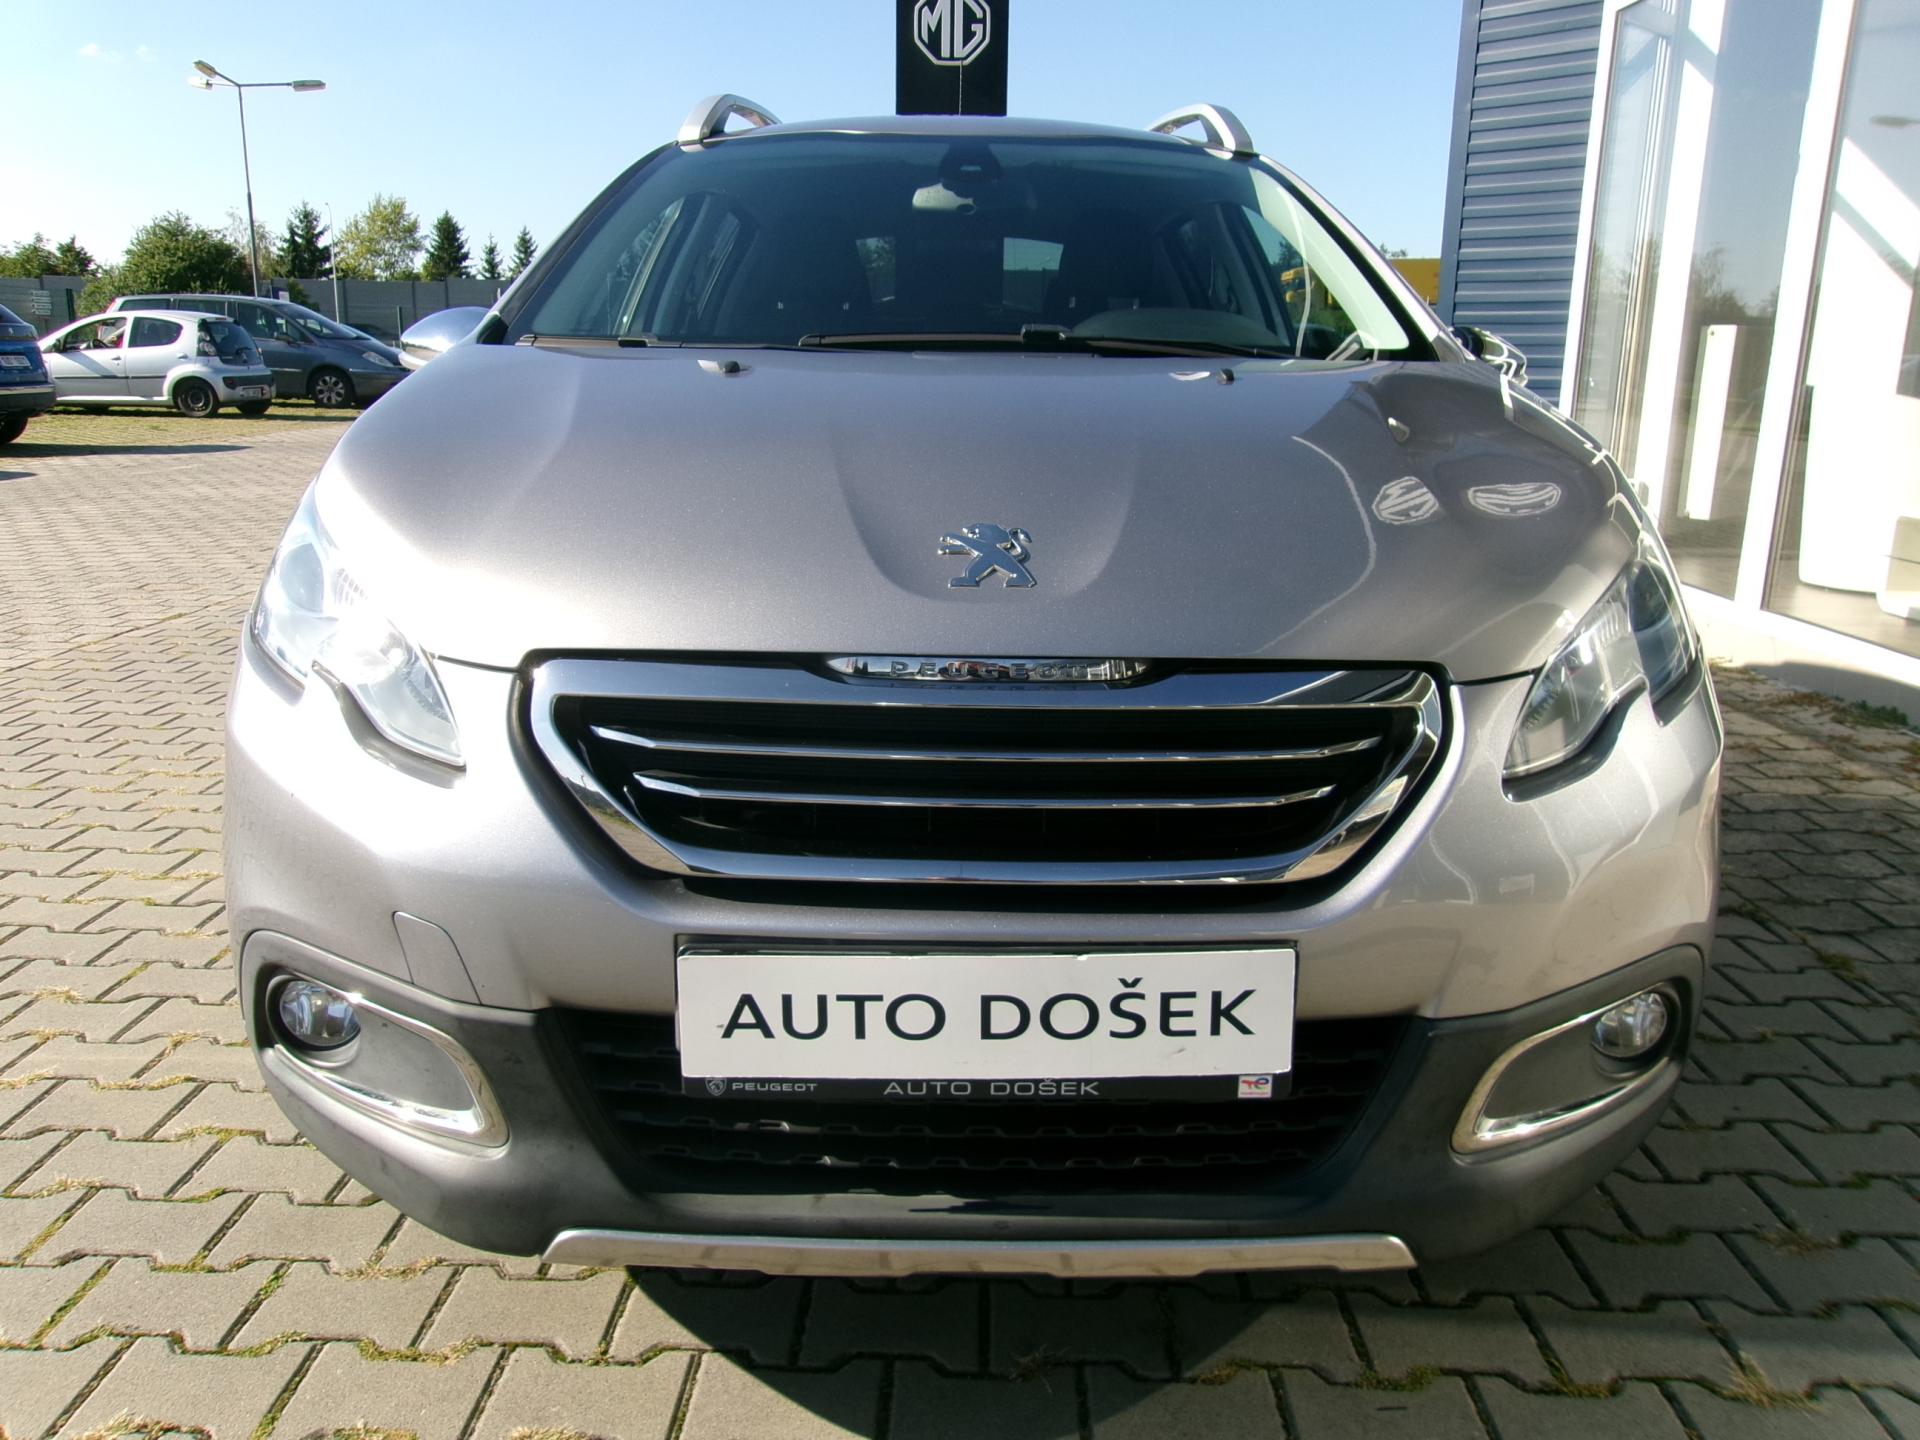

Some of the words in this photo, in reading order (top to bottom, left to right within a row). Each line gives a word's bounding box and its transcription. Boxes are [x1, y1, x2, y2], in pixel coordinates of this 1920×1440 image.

[921, 0, 984, 58] MG
[721, 993, 947, 1040] AUTO
[980, 977, 1257, 1040] DOŠEK
[731, 1082, 818, 1092] PEUGEOT
[883, 1081, 972, 1095] AUTO
[990, 1077, 1099, 1095] DOŠEK
